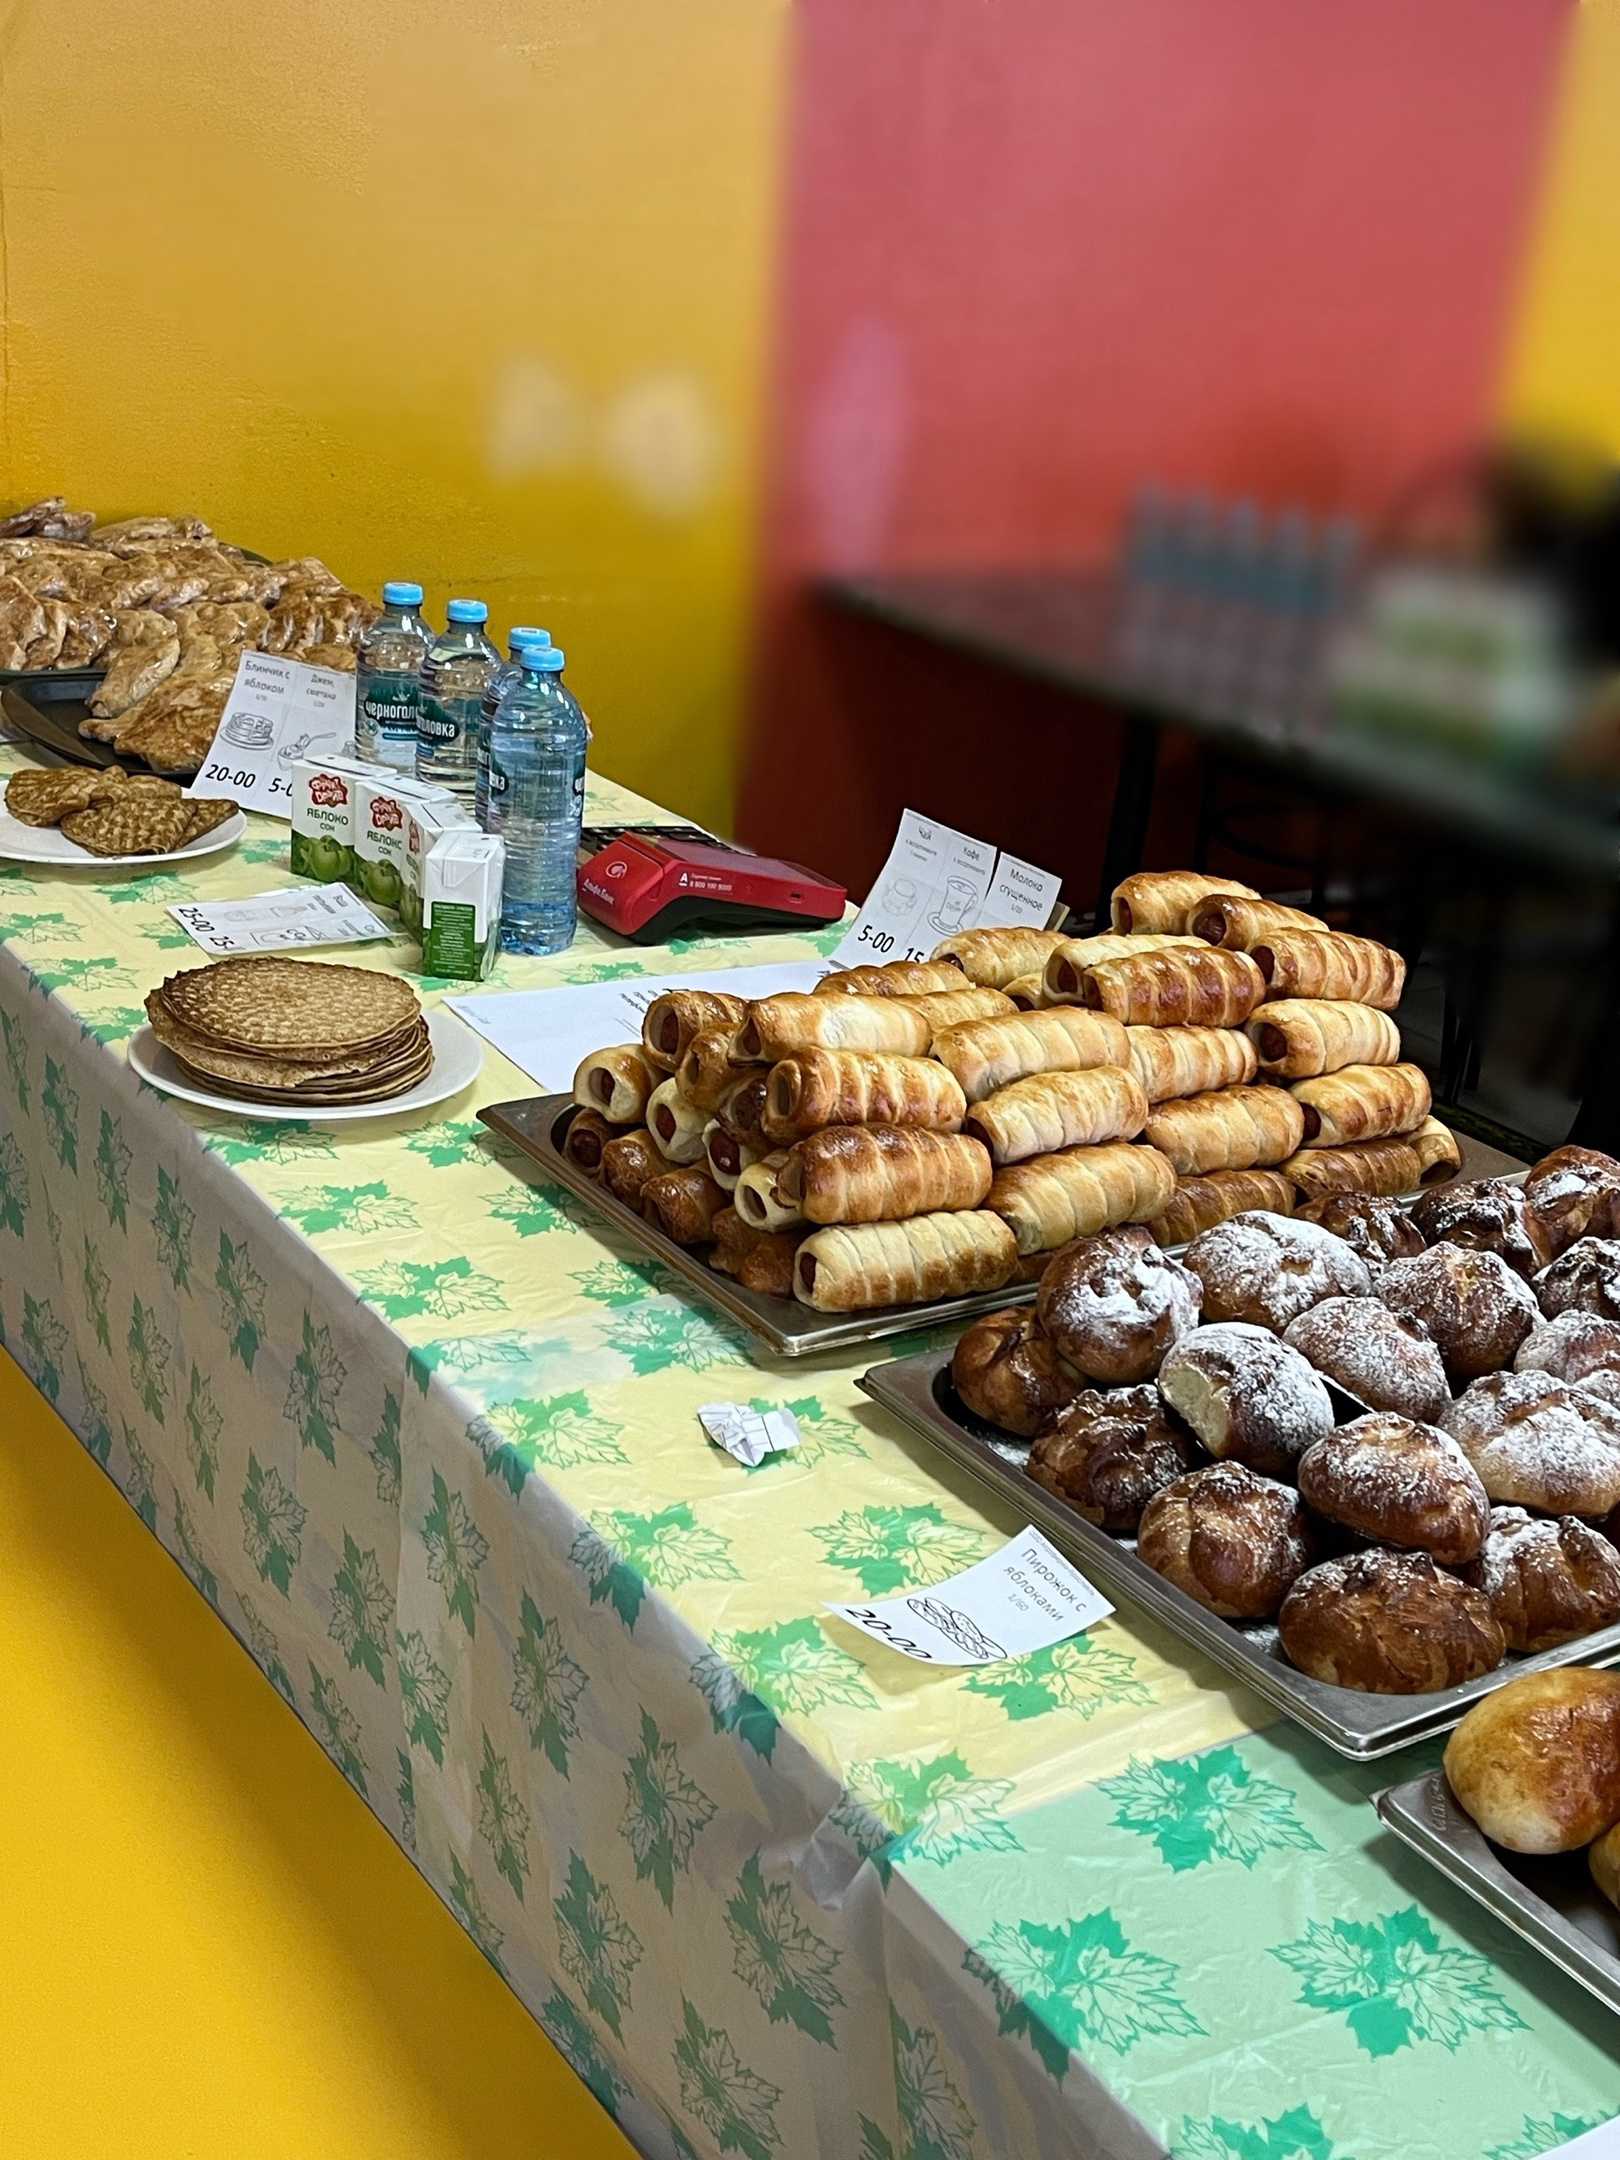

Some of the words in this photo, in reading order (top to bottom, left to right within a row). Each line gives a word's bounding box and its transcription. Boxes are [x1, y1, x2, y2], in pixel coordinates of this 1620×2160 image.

[245, 660, 283, 677] Блинчик
[244, 677, 284, 695] яблоком
[205, 764, 256, 788] 20-00
[307, 808, 349, 826] ЯБЛОКО
[963, 847, 980, 861] Кофе
[1010, 868, 1043, 892] Молоко
[999, 884, 1043, 911] сгущенное
[178, 907, 215, 932] 25-00
[857, 924, 895, 953] 5-00
[1021, 1548, 1078, 1604] Пирожок
[1075, 1603, 1087, 1612] с
[1003, 1566, 1064, 1621] яблоками
[845, 1608, 933, 1659] 20-00
